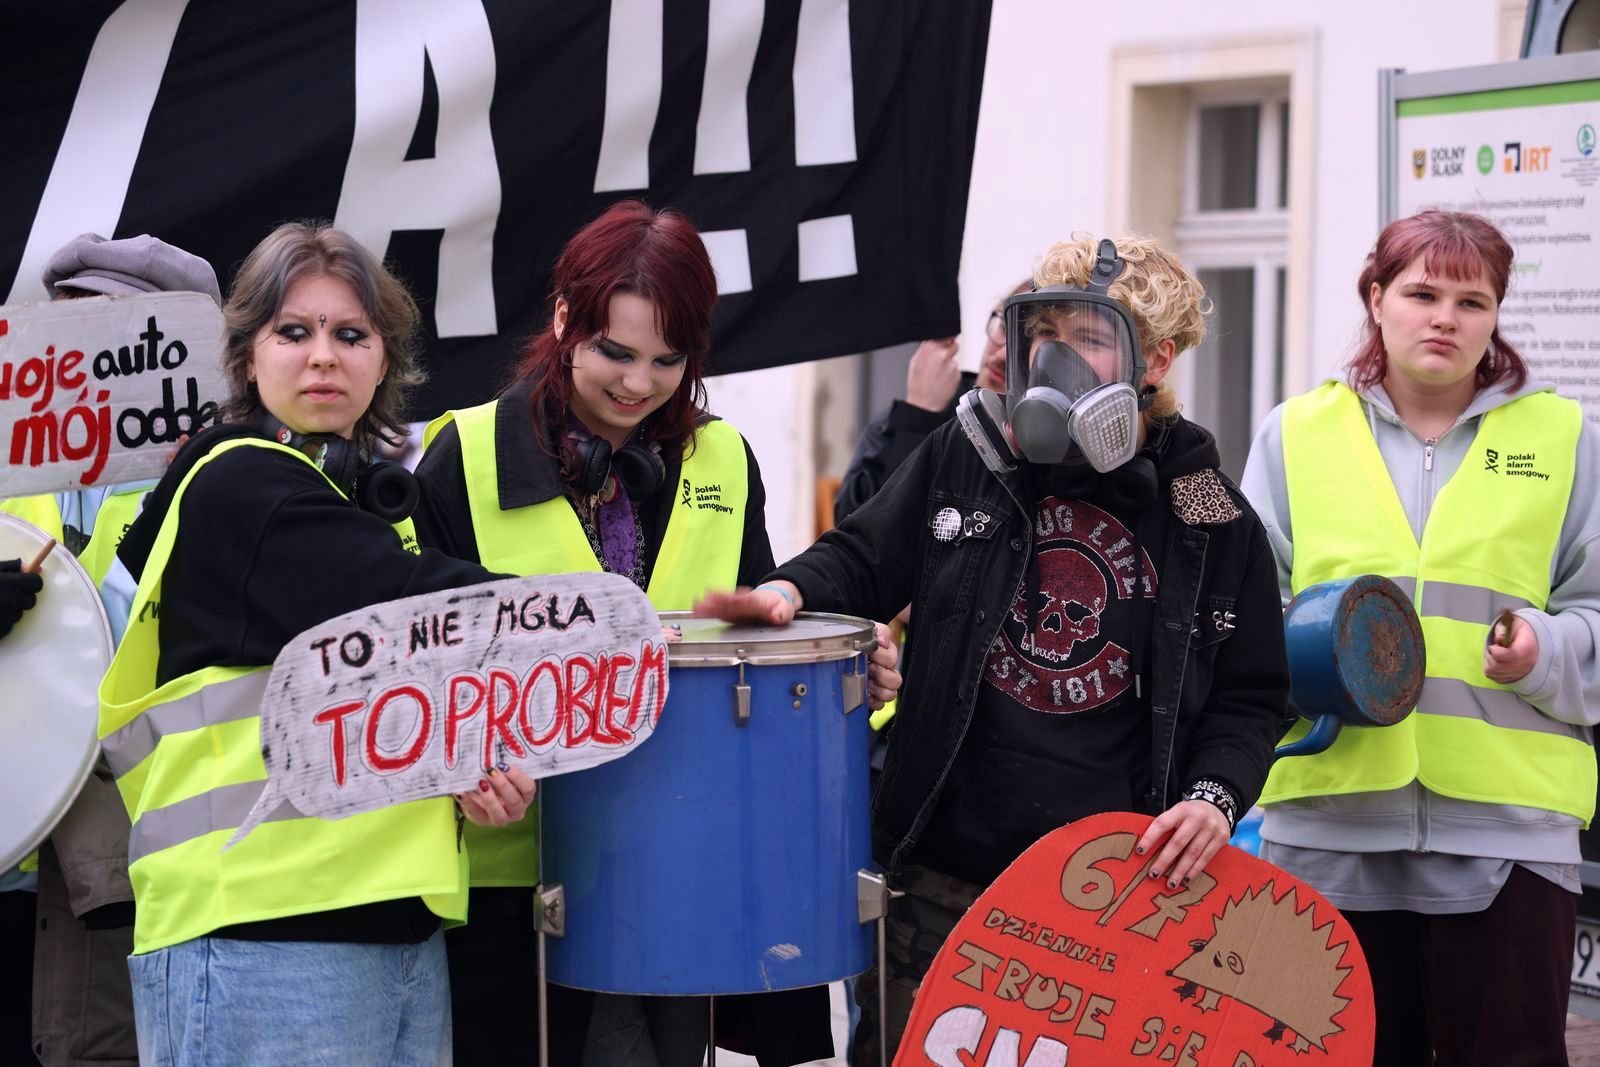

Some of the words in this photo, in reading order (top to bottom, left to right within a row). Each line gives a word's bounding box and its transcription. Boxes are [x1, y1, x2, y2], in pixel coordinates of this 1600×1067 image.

[1523, 147, 1551, 172] IRT
[0, 319, 87, 412] oje
[93, 315, 188, 380] auto
[9, 387, 111, 486] mój
[116, 377, 223, 448] odde
[695, 484, 721, 494] polski
[1506, 470, 1550, 481] smogowy
[696, 494, 721, 502] alarm
[697, 503, 734, 515] smogowy
[310, 631, 375, 676] TO
[408, 610, 464, 655] NIE
[1051, 669, 1105, 706] 187
[1060, 831, 1218, 942] 6/7
